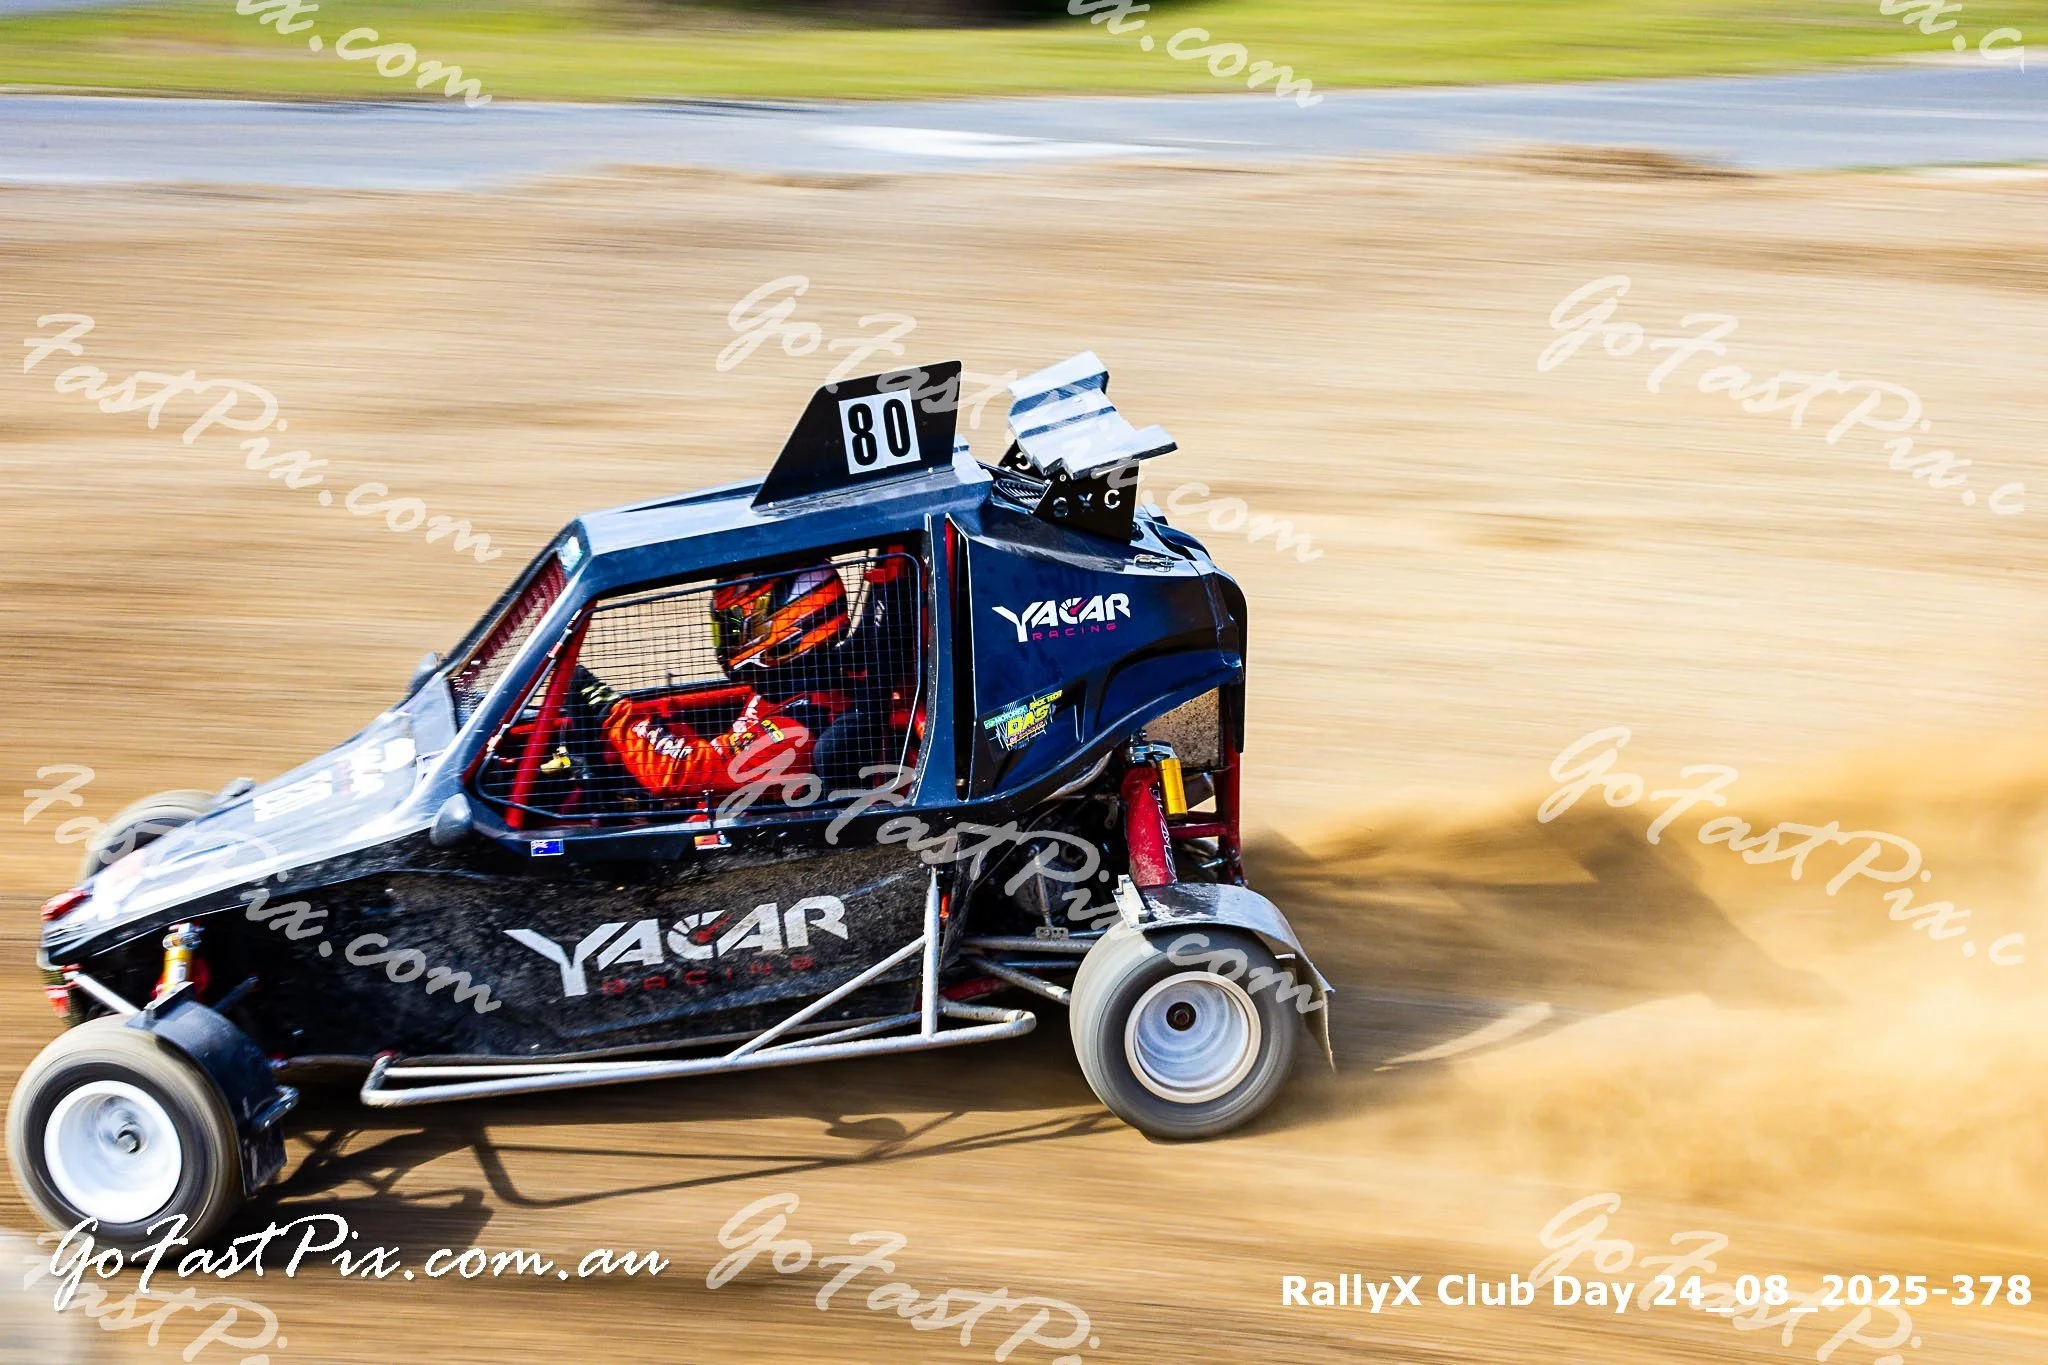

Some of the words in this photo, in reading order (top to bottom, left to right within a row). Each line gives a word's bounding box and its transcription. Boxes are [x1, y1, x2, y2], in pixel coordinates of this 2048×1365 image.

[847, 398, 911, 466] 80
[992, 593, 1131, 642] YACAR
[1031, 622, 1117, 641] RACING
[503, 895, 849, 997] YACAR
[601, 955, 814, 995] RACING
